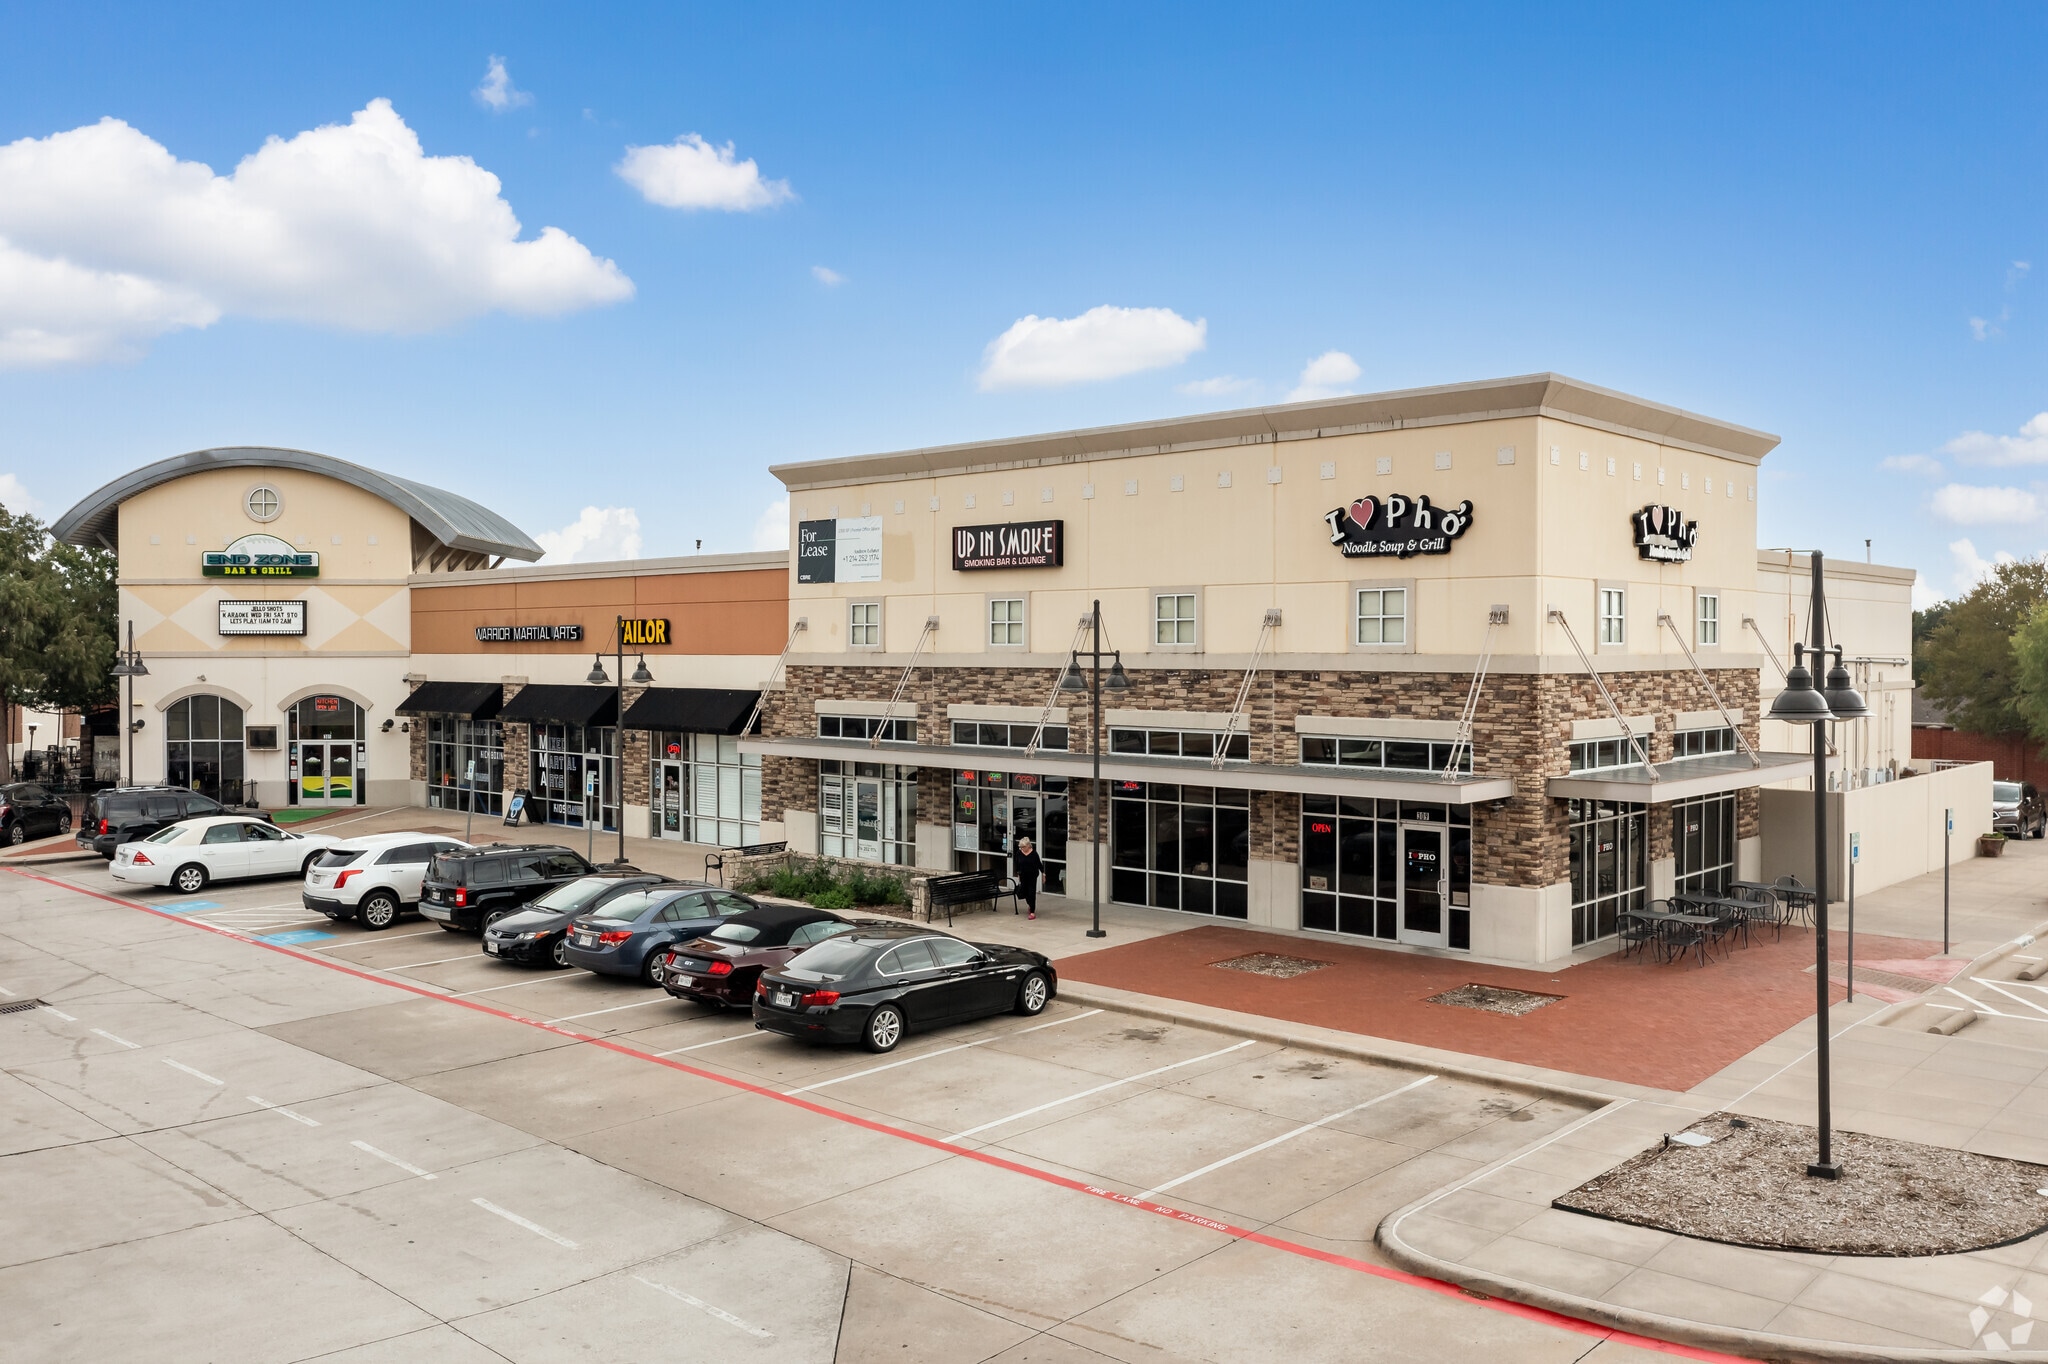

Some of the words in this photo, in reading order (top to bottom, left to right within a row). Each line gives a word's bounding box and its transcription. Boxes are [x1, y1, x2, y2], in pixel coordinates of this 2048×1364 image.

[1324, 510, 1345, 544] I
[800, 528, 817, 543] For
[957, 530, 976, 559] UP
[980, 530, 994, 557] IN
[1000, 526, 1053, 556] SMOKE
[800, 543, 828, 557] Lease
[1342, 541, 1377, 554] Noodle
[1379, 540, 1404, 555] Soup
[1406, 539, 1417, 551] &
[1419, 537, 1445, 550] Grill
[206, 553, 251, 565] END
[254, 553, 313, 566] ZONE
[964, 558, 996, 568] SMOKING
[996, 557, 1011, 566] BAR
[1012, 557, 1018, 565] &
[1018, 555, 1047, 565] LOUNGE
[224, 566, 247, 575] BAR
[250, 567, 257, 575] &
[261, 567, 293, 575] GRILL
[474, 627, 511, 641] WARRIOR
[513, 626, 551, 641] MARTIAL
[552, 626, 577, 640] ARTS
[617, 619, 667, 644] AILOR
[668, 744, 681, 755] OPEN
[1416, 811, 1430, 821] 309
[1311, 822, 1332, 833] OPEN
[1408, 851, 1413, 859] I
[1418, 853, 1436, 861] PHO
[1084, 1185, 1110, 1196] FIRE
[1112, 1194, 1144, 1206] LANE
[1155, 1206, 1173, 1215] NO
[1177, 1213, 1229, 1232] PARKING
